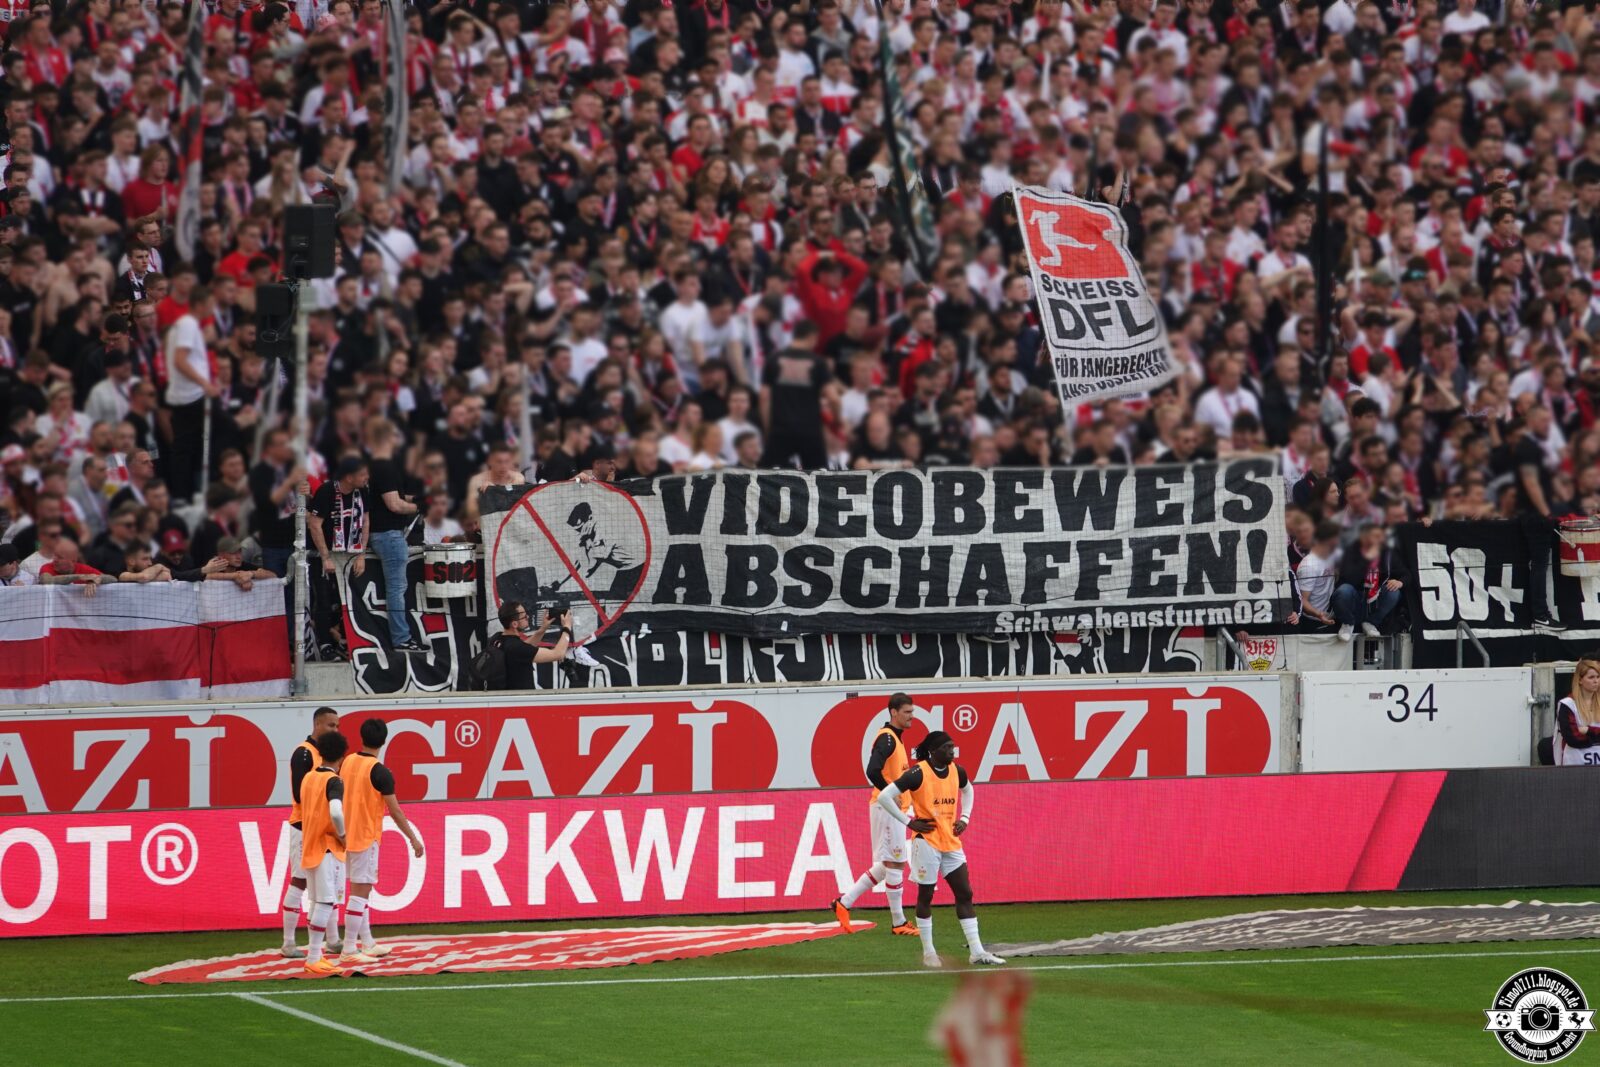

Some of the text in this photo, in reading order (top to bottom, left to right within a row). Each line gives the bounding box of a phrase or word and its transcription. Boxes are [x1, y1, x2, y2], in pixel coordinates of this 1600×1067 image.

[1041, 273, 1139, 299] SCHEISS
[1048, 298, 1156, 341] DFL
[1055, 353, 1079, 378] FÜR
[659, 458, 1274, 540] VIDEOBEWEIS
[652, 529, 1268, 609] ABSCHAFFEN!
[995, 600, 1273, 633] Schwabensturm02
[1387, 683, 1438, 723] 34
[238, 801, 938, 914] WORKWEA
